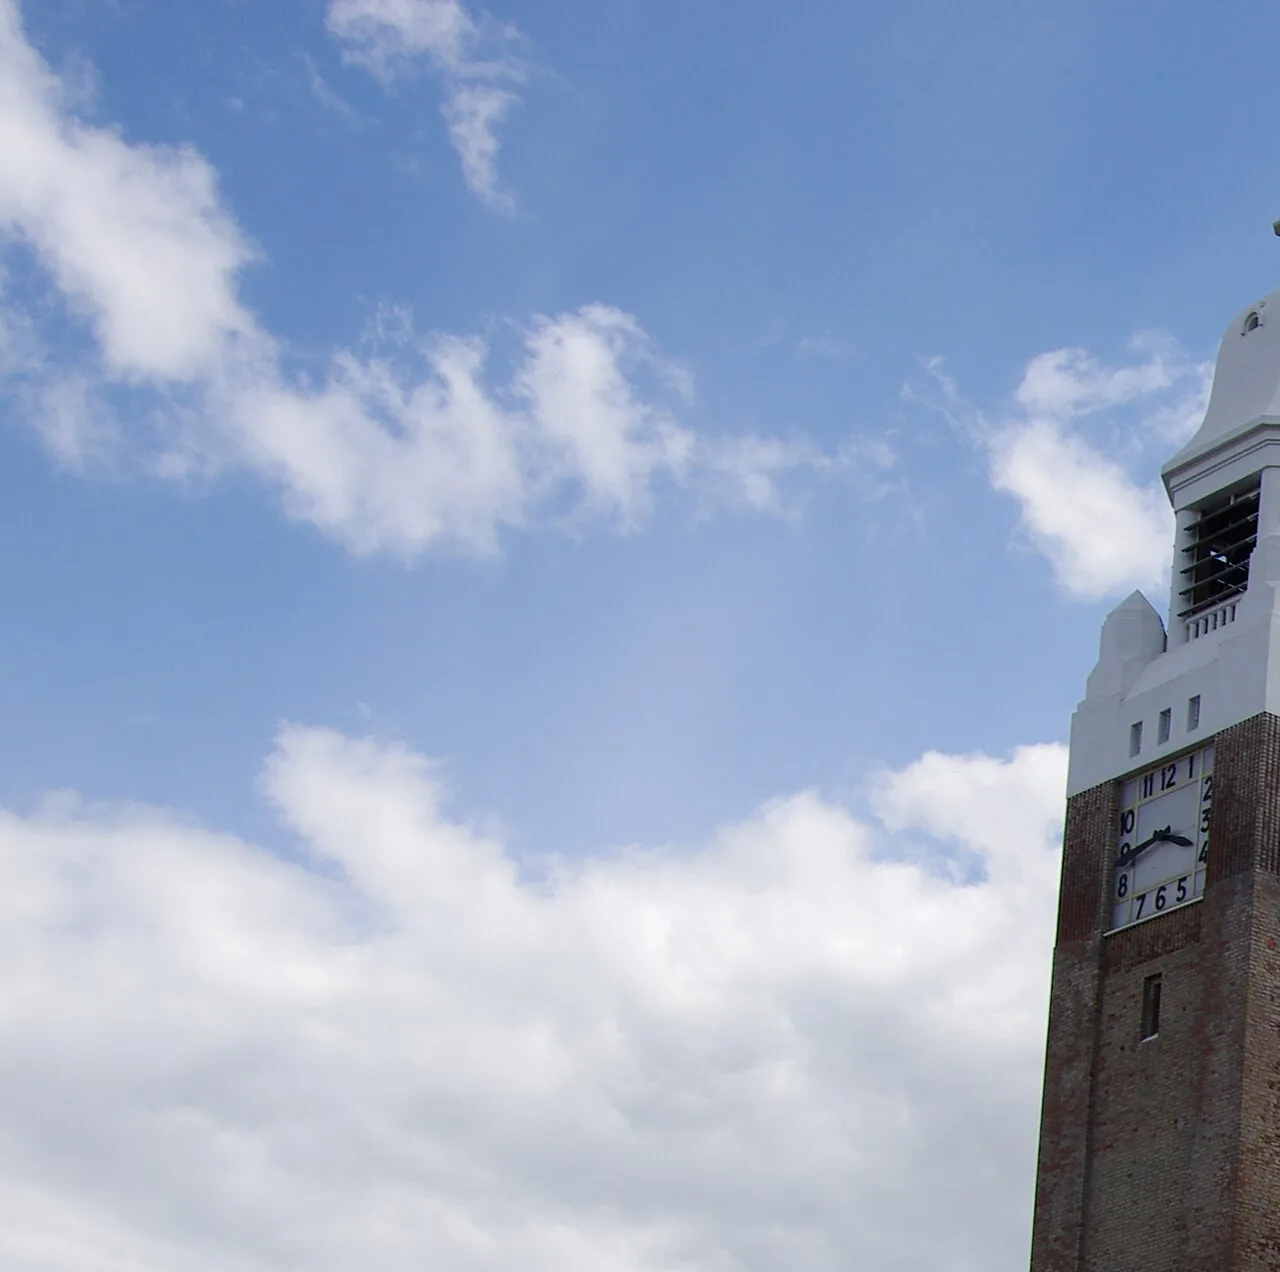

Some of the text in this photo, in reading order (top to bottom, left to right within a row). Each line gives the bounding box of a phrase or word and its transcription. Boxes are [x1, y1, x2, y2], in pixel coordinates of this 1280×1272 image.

[1142, 755, 1195, 798] 11 12 1
[1203, 776, 1213, 802] 2
[1120, 809, 1135, 836] 10
[1200, 807, 1212, 833] 3
[1198, 840, 1209, 863] 4
[1117, 874, 1128, 898] 8
[1136, 876, 1188, 920] 7 6 5
